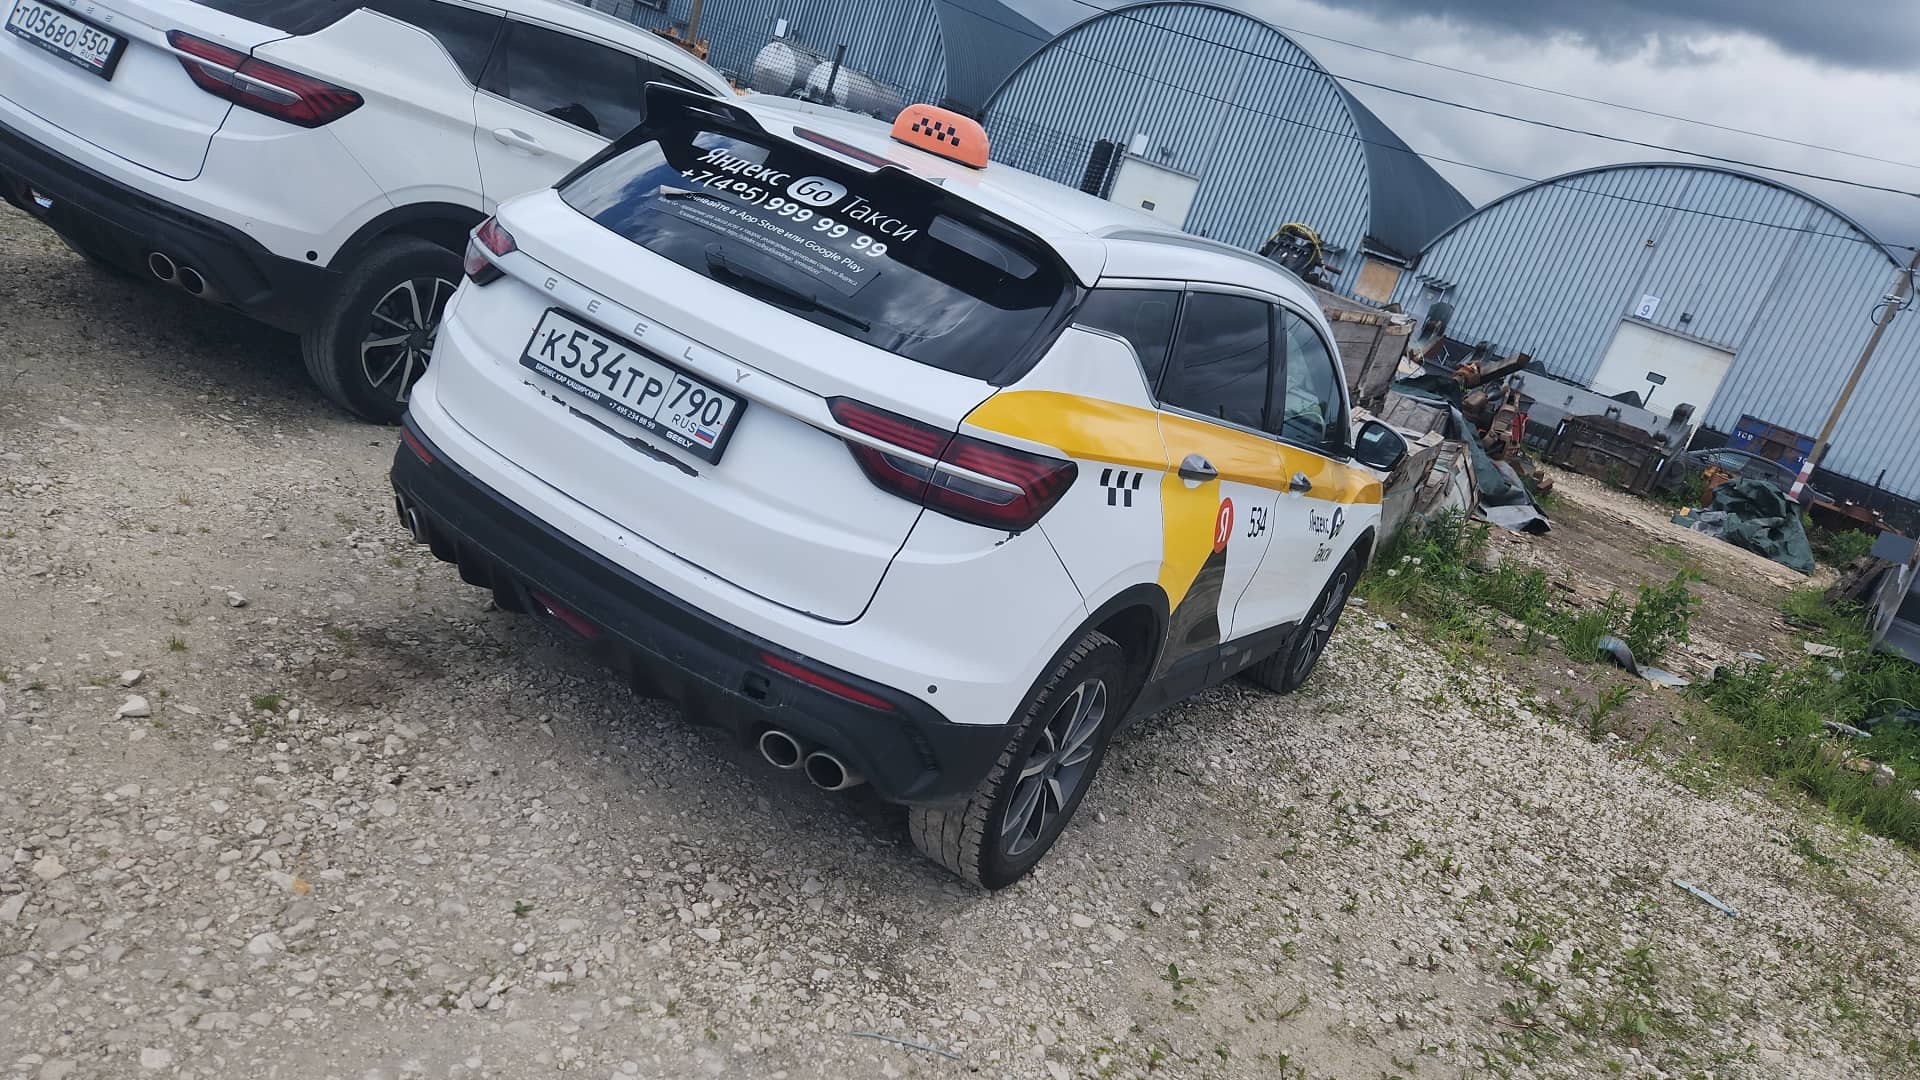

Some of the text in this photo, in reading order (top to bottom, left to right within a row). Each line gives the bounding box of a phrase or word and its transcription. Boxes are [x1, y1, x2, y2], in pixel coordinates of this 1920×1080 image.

[79, 27, 109, 55] 550
[697, 148, 791, 186] Яндекс
[795, 179, 834, 203] Go
[841, 195, 918, 242] Такси
[736, 211, 758, 224] App
[757, 219, 785, 235] Store
[784, 231, 805, 244] или
[805, 240, 842, 262] Google
[841, 256, 865, 274] Play
[812, 218, 849, 238] 99
[850, 235, 888, 257] 99
[1641, 304, 1650, 316] 9
[544, 277, 751, 384] GEELY
[540, 328, 722, 427] К534ТР 790
[535, 362, 556, 380] БИЗНЕС
[556, 373, 568, 386] КАР
[616, 404, 628, 416] 495
[666, 430, 694, 449] GEELY
[672, 413, 697, 433] RUS
[1216, 507, 1229, 543] Я
[1247, 506, 1268, 538] 534
[1309, 508, 1329, 536] Яндекс
